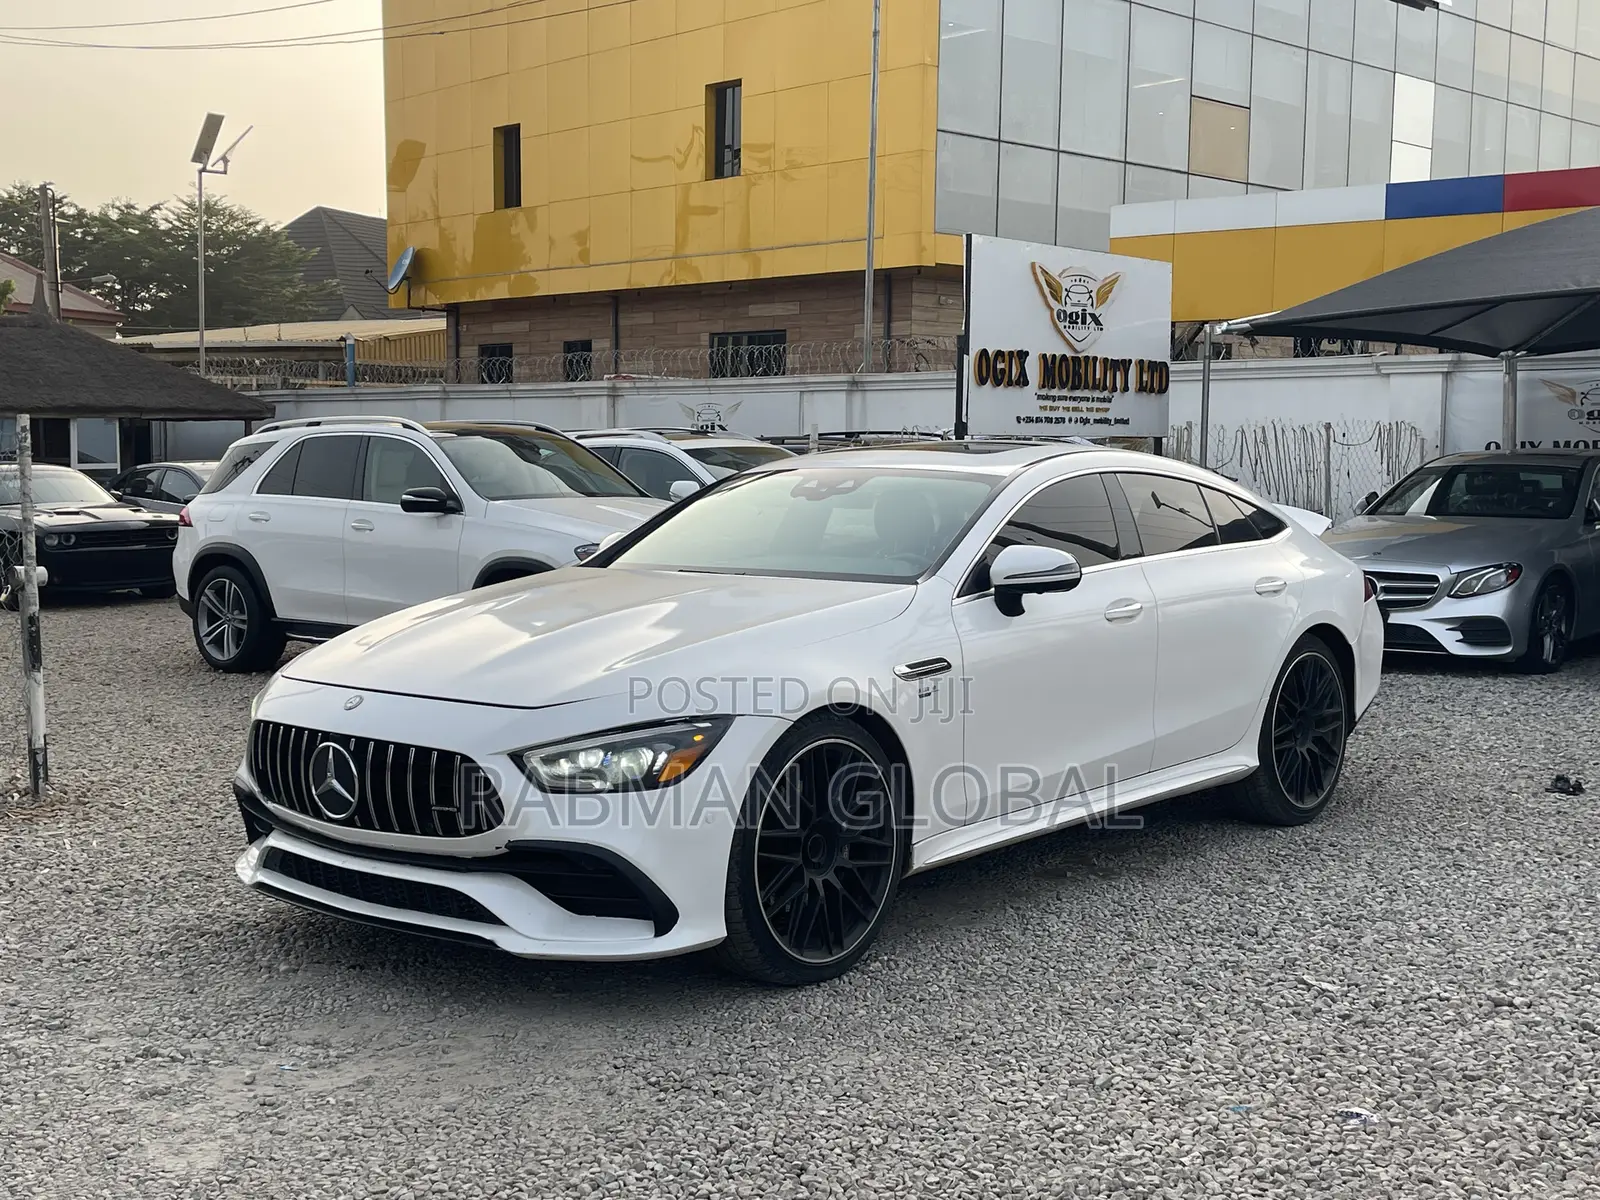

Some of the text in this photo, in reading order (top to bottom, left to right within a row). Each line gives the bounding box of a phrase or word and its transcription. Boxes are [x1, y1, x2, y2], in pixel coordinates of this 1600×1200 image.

[1056, 308, 1104, 327] Ogix
[974, 348, 1170, 394] OGIX MOBILITY LTD
